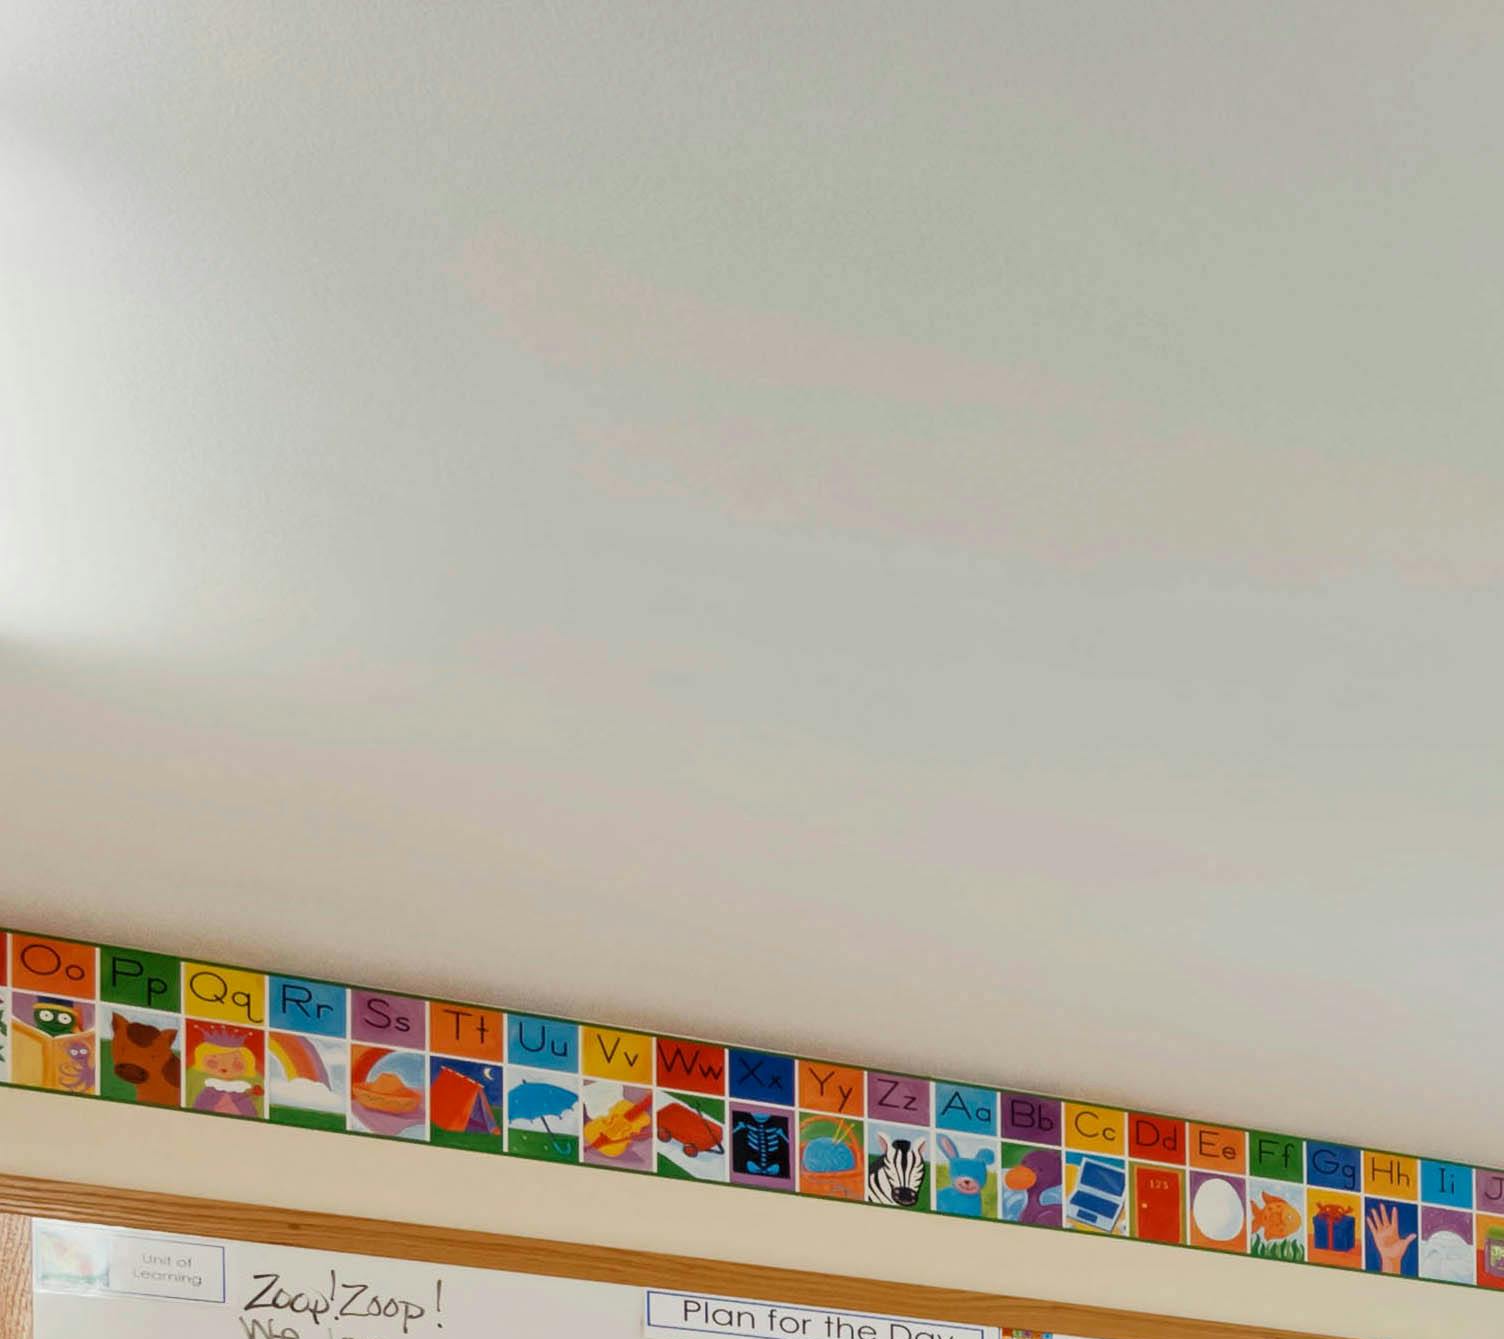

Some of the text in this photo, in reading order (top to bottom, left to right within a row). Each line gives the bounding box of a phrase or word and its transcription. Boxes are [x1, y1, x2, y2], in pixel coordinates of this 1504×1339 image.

[20, 943, 85, 982] Oo
[111, 957, 168, 1008] Pp
[189, 971, 264, 1024] Qq
[281, 984, 334, 1020] Rr
[363, 998, 411, 1034] Ss
[445, 1012, 490, 1045] Tt
[519, 1022, 569, 1058] Uu
[597, 1036, 639, 1067] Vv
[657, 1044, 723, 1082] Ww
[808, 1070, 854, 1113] Yy
[876, 1079, 919, 1113] Zz
[941, 1091, 992, 1126] Aa
[1010, 1100, 1054, 1134] Bb
[1073, 1111, 1116, 1144] Cc
[142, 1253, 192, 1268] Unit of
[132, 1267, 203, 1287] Learning
[682, 1299, 756, 1330] Plan
[768, 1307, 812, 1335] for
